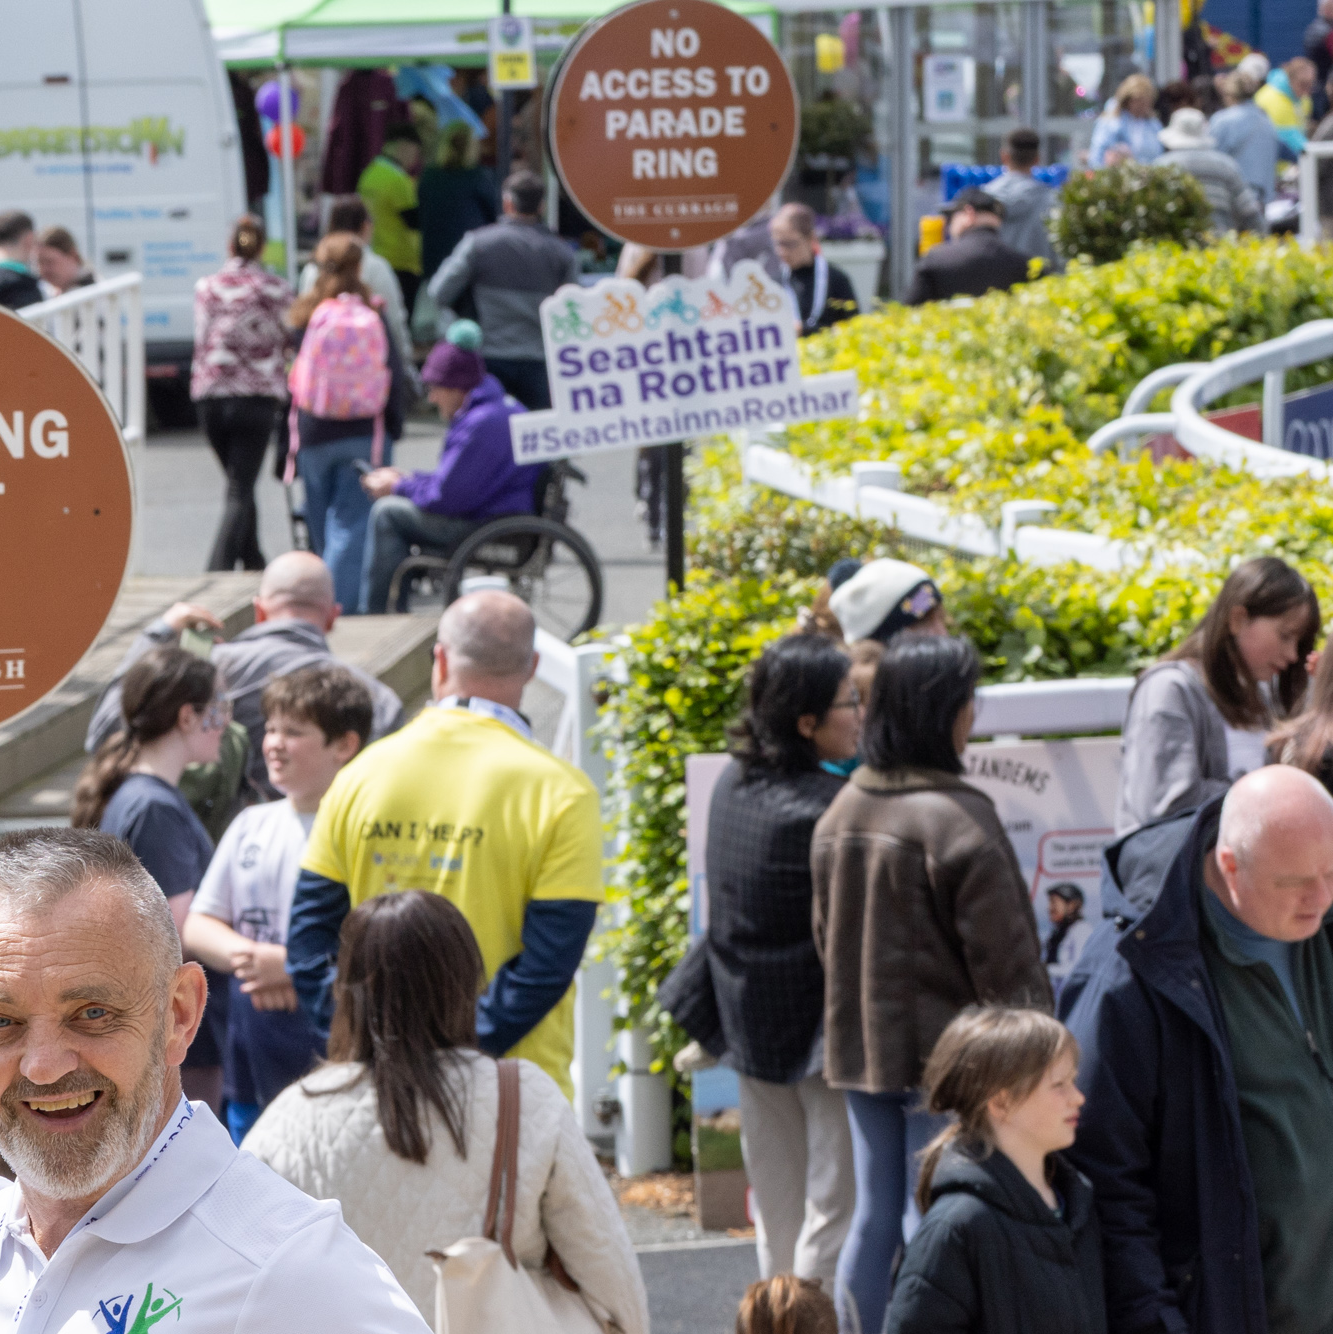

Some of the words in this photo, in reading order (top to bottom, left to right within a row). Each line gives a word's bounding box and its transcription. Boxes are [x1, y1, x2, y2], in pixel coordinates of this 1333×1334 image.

[650, 28, 700, 58] NO
[580, 67, 717, 101] ACCESS
[725, 66, 770, 96] TO
[605, 106, 746, 140] PARADE
[633, 147, 718, 180] RING
[557, 320, 782, 379] Seachtain
[570, 382, 623, 413] na
[638, 358, 791, 402] Rothar
[521, 389, 853, 456] #SeachtainnaRothar
